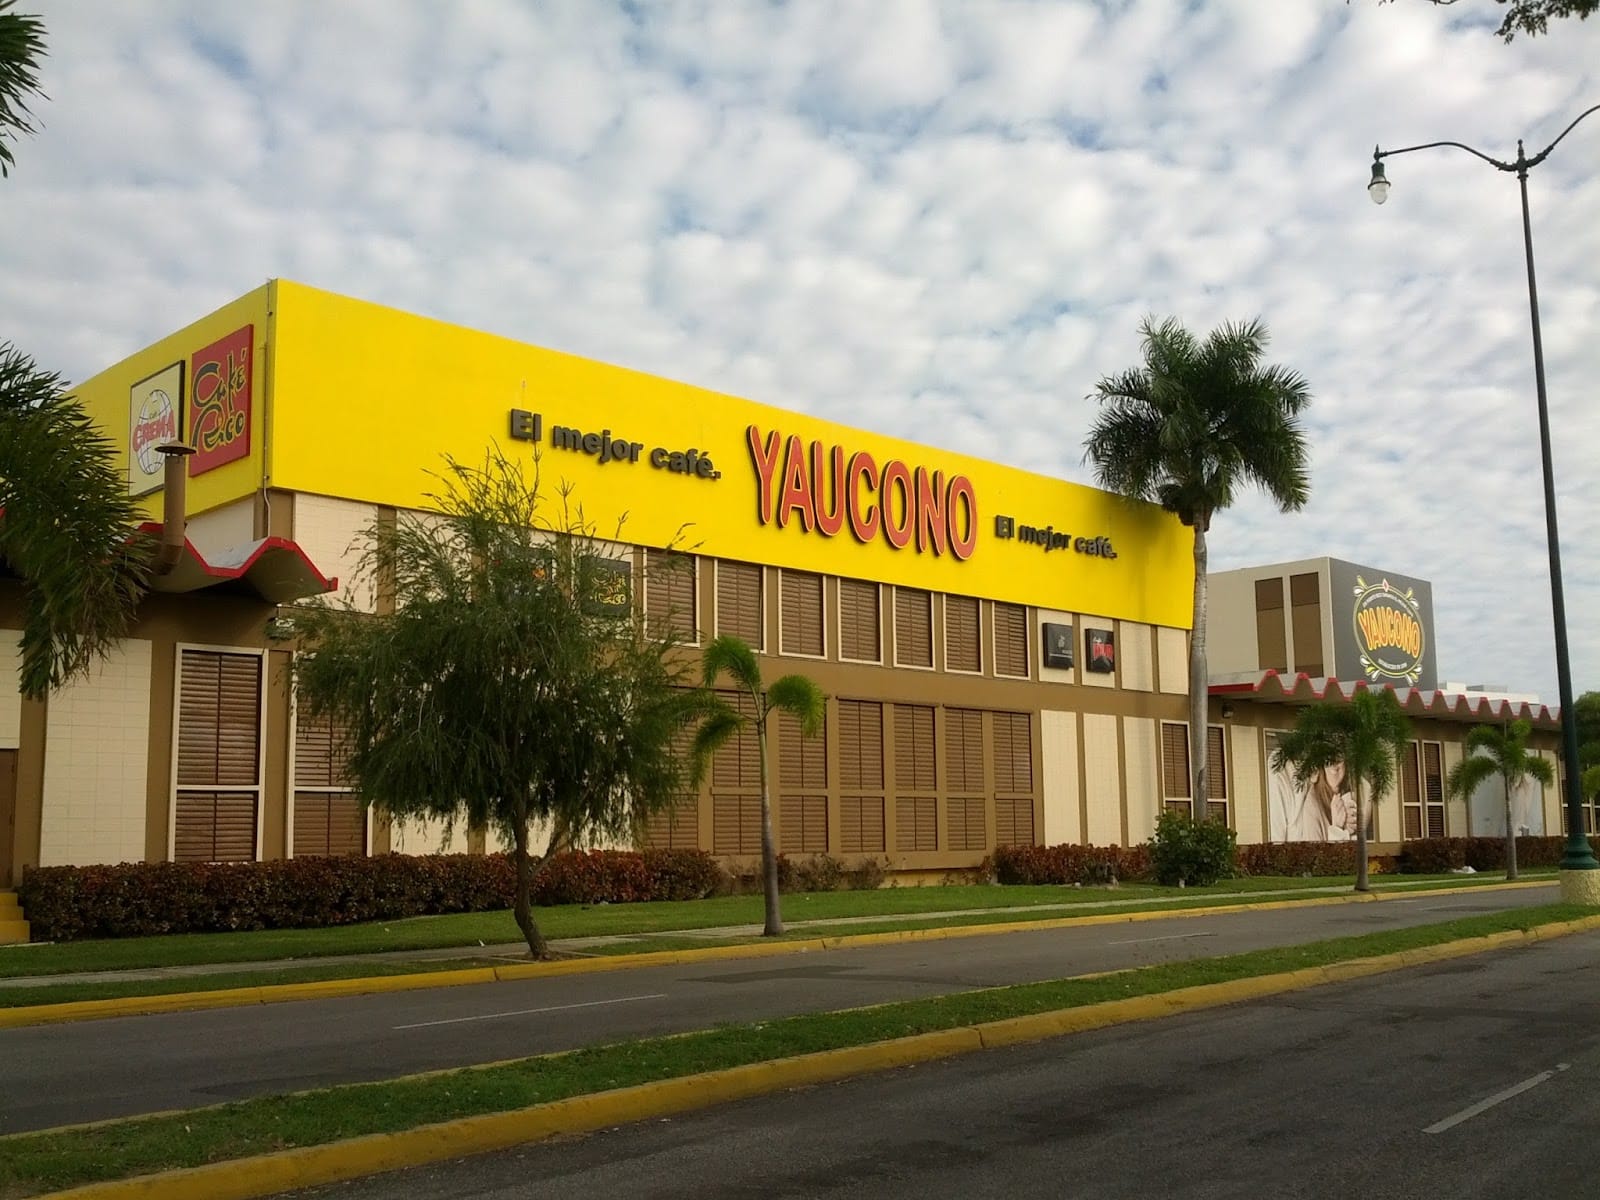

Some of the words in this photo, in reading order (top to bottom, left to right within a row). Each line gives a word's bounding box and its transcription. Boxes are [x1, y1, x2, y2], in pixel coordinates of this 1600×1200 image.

[133, 408, 176, 452] CREMA
[191, 403, 246, 457] Rico
[510, 408, 542, 442] El
[552, 425, 643, 464] mejor
[651, 446, 722, 480] café.
[746, 424, 978, 560] YAUCONO
[995, 515, 1015, 539] El
[1018, 525, 1072, 553] mejor
[1074, 536, 1118, 559] café.
[1358, 606, 1420, 658] YAUCONO
